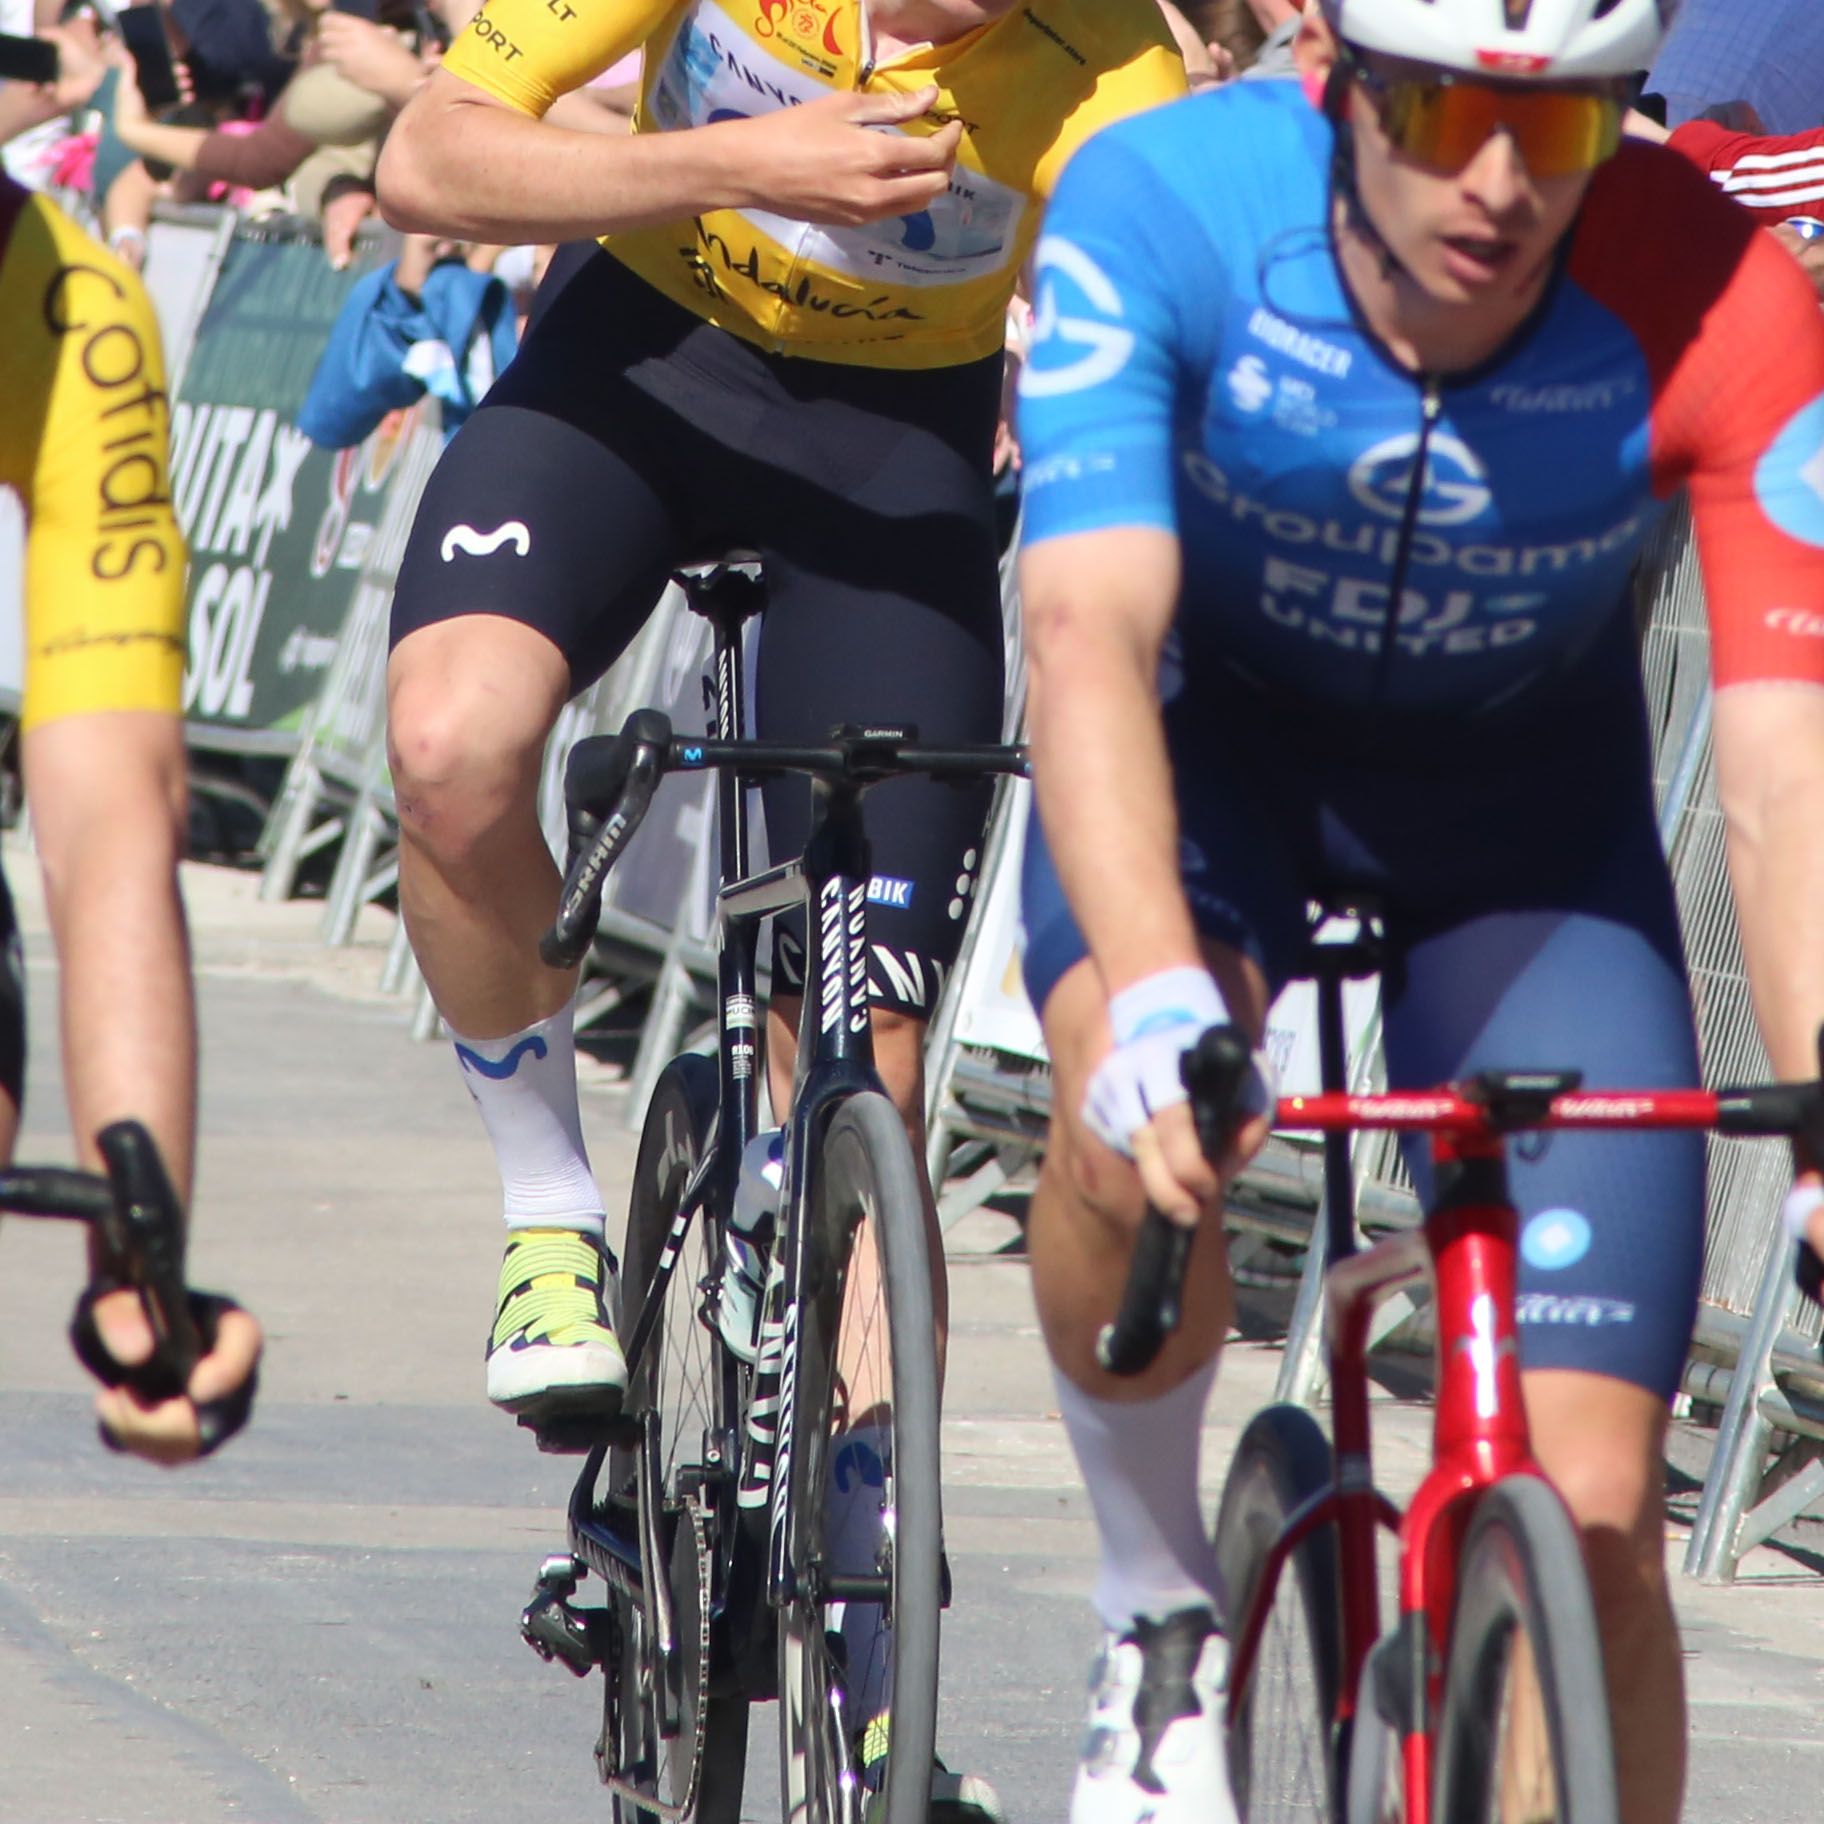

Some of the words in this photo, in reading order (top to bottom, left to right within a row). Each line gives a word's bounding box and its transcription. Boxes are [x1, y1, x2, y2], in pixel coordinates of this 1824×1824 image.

[44, 262, 171, 582] Cofidis
[1181, 449, 1640, 578] Groupama
[1260, 595, 1538, 657] UNITED
[1264, 555, 1474, 634] FDJ
[864, 729, 904, 739] GARMIN
[867, 877, 910, 905] BIK
[821, 876, 846, 1034] CANYON
[848, 881, 868, 1034] CANYON
